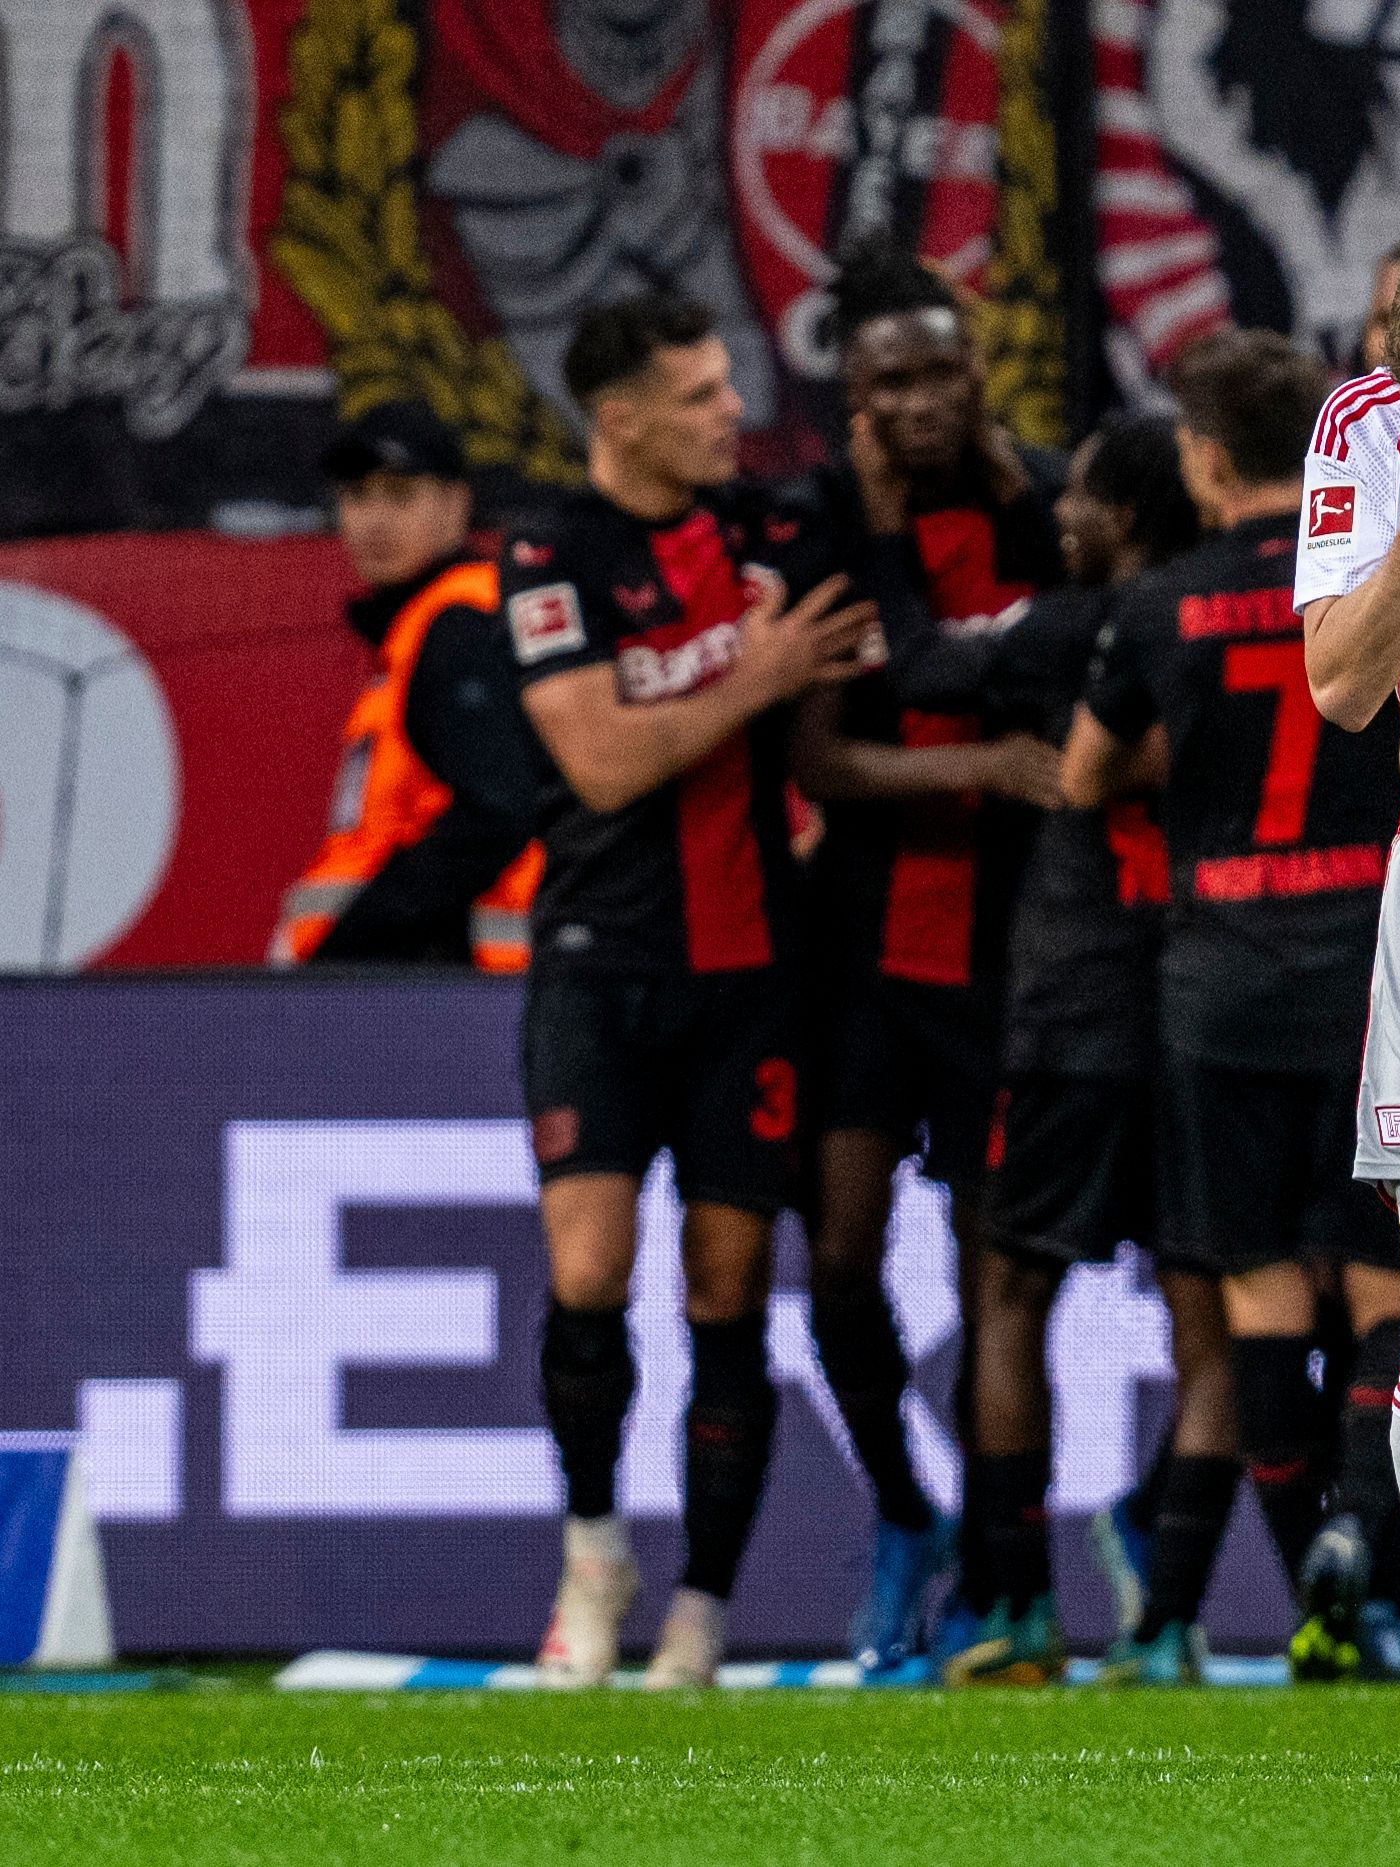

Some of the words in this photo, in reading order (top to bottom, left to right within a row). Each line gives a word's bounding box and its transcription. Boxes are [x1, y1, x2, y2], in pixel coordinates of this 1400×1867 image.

[1307, 538, 1352, 550] BUNDESLIGA
[1224, 640, 1322, 846] 7
[750, 1057, 797, 1141] 3
